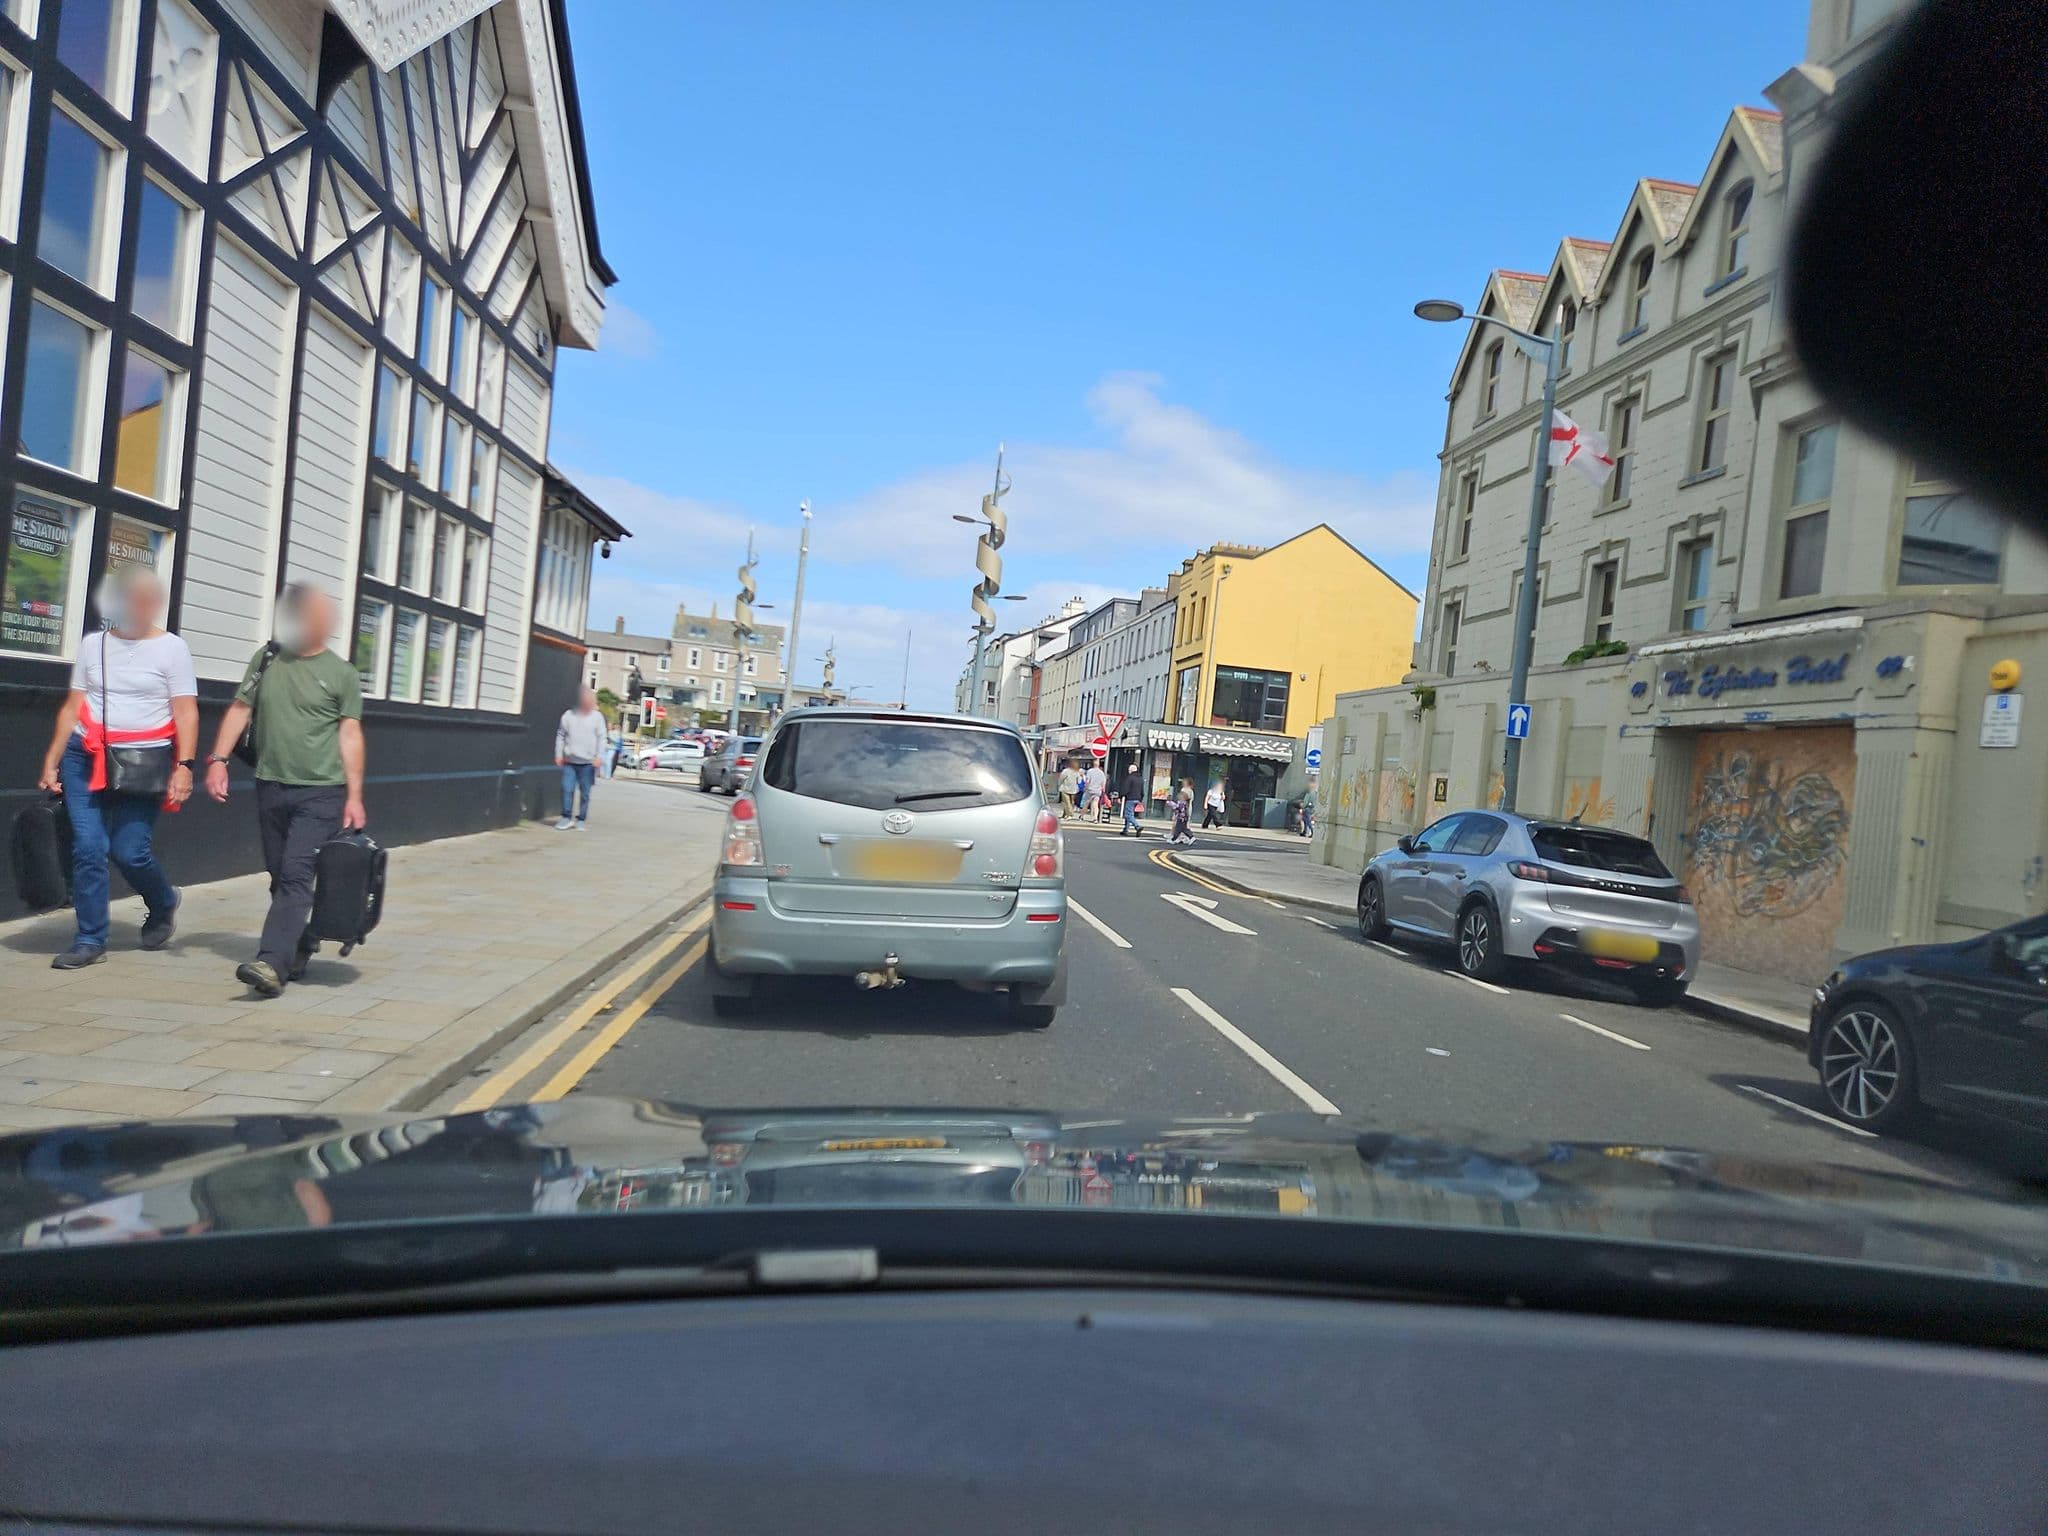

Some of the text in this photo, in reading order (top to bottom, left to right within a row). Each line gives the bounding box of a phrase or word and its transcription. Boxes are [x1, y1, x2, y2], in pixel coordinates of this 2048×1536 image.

[30, 520, 68, 543] STATION
[122, 543, 154, 564] STATION
[23, 614, 41, 627] YOUR
[17, 629, 46, 644] STATION
[1148, 729, 1190, 745] MAUDS
